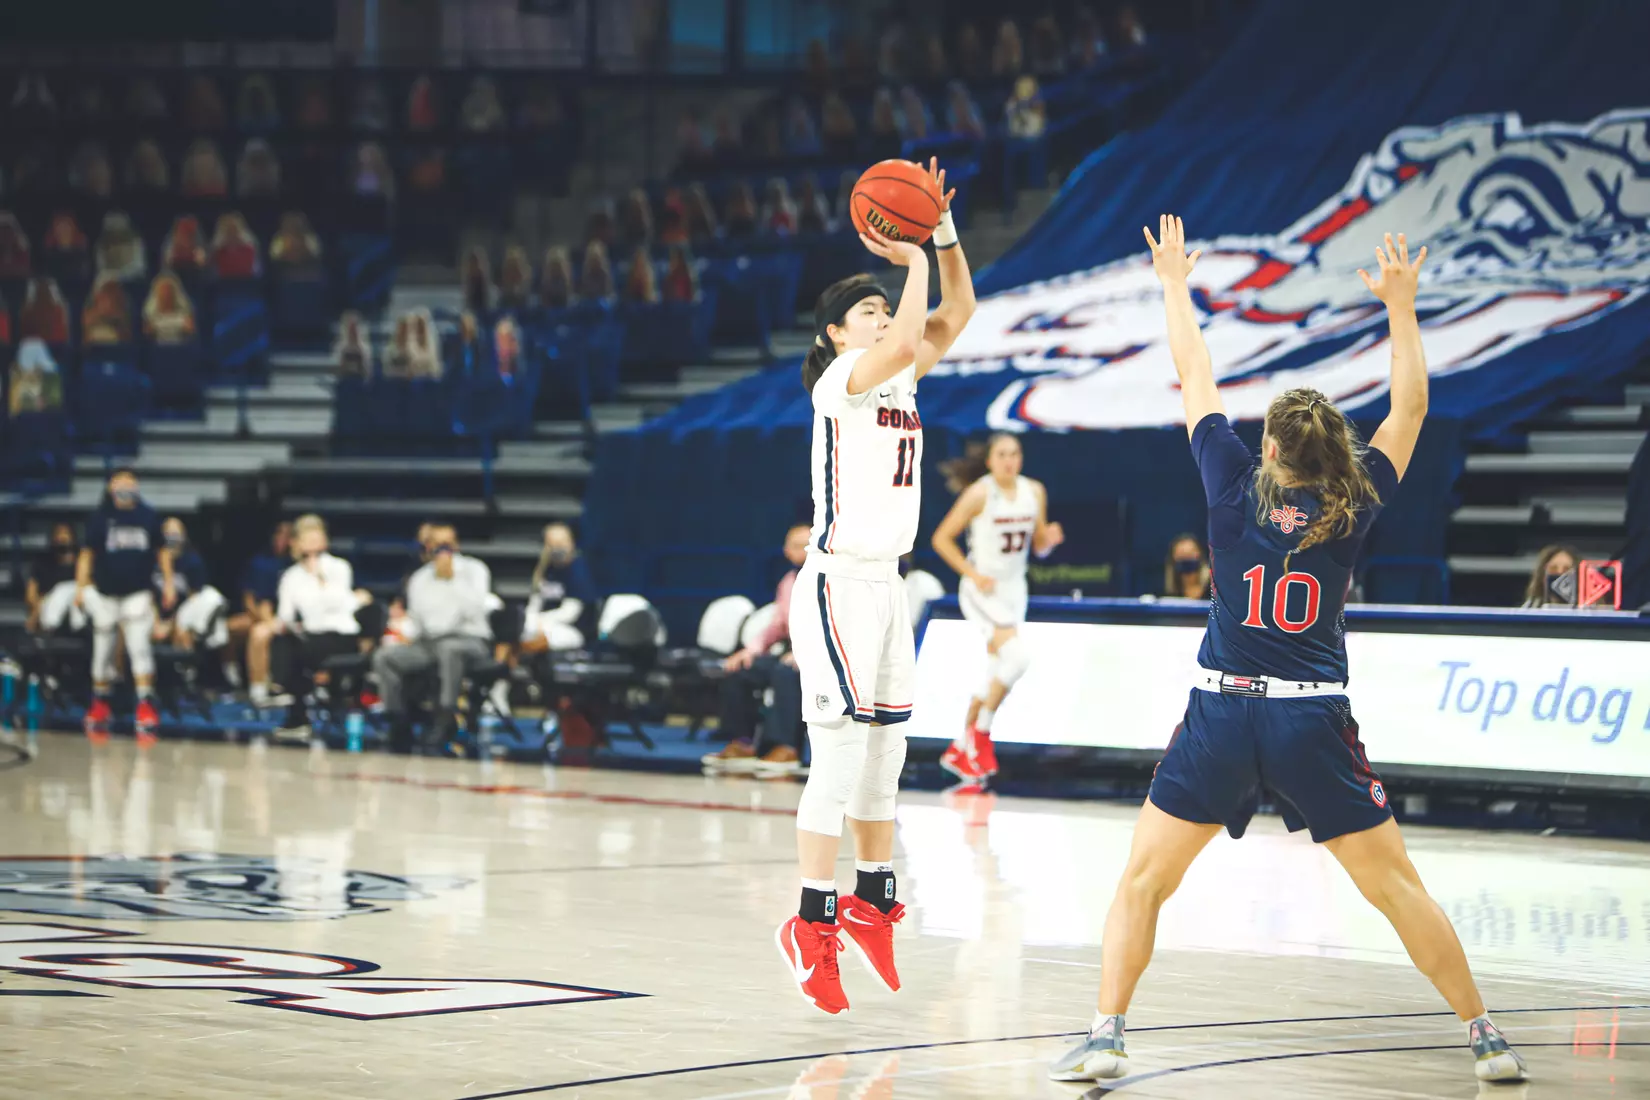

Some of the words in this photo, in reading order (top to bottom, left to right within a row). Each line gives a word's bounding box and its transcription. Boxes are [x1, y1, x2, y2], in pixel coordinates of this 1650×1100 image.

[866, 207, 920, 243] Wilson
[892, 437, 915, 487] 11
[1241, 564, 1321, 633] 10
[1438, 661, 1518, 731] Top
[1532, 667, 1632, 743] dog
